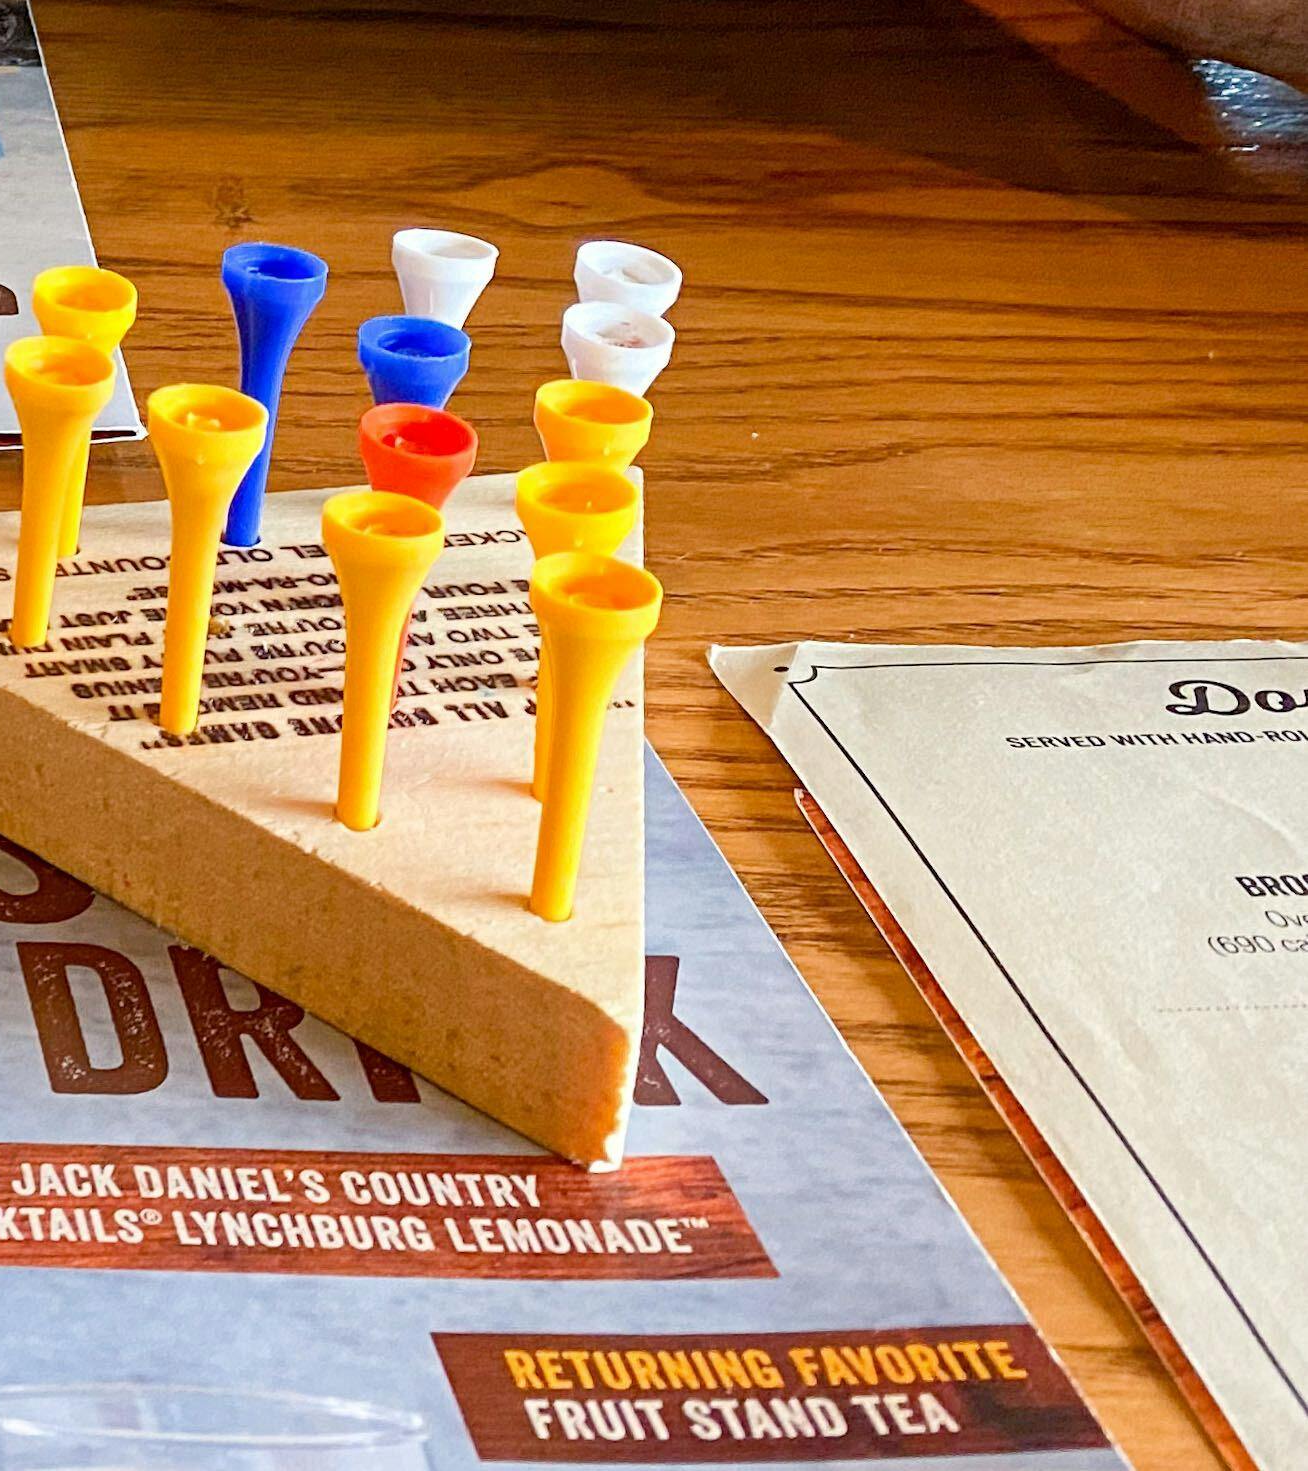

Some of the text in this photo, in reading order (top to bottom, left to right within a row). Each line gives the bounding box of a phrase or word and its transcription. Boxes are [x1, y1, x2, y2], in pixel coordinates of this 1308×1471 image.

[60, 610, 132, 628] JUST
[63, 633, 153, 651] PLAIN
[446, 626, 518, 643] TWO
[24, 658, 129, 678] SMART
[417, 650, 503, 669] ONLY
[430, 674, 516, 695] EACH
[1007, 733, 1178, 748] SERVED WITH
[18, 942, 769, 1105] DRK
[11, 1164, 122, 1199] JACK
[341, 1167, 540, 1211] COUNTRY
[175, 1211, 437, 1252] LYNCHBURG
[504, 1341, 1029, 1389] RETURNING FAVORITE
[521, 1391, 960, 1443] FRUIT STAND TEA
